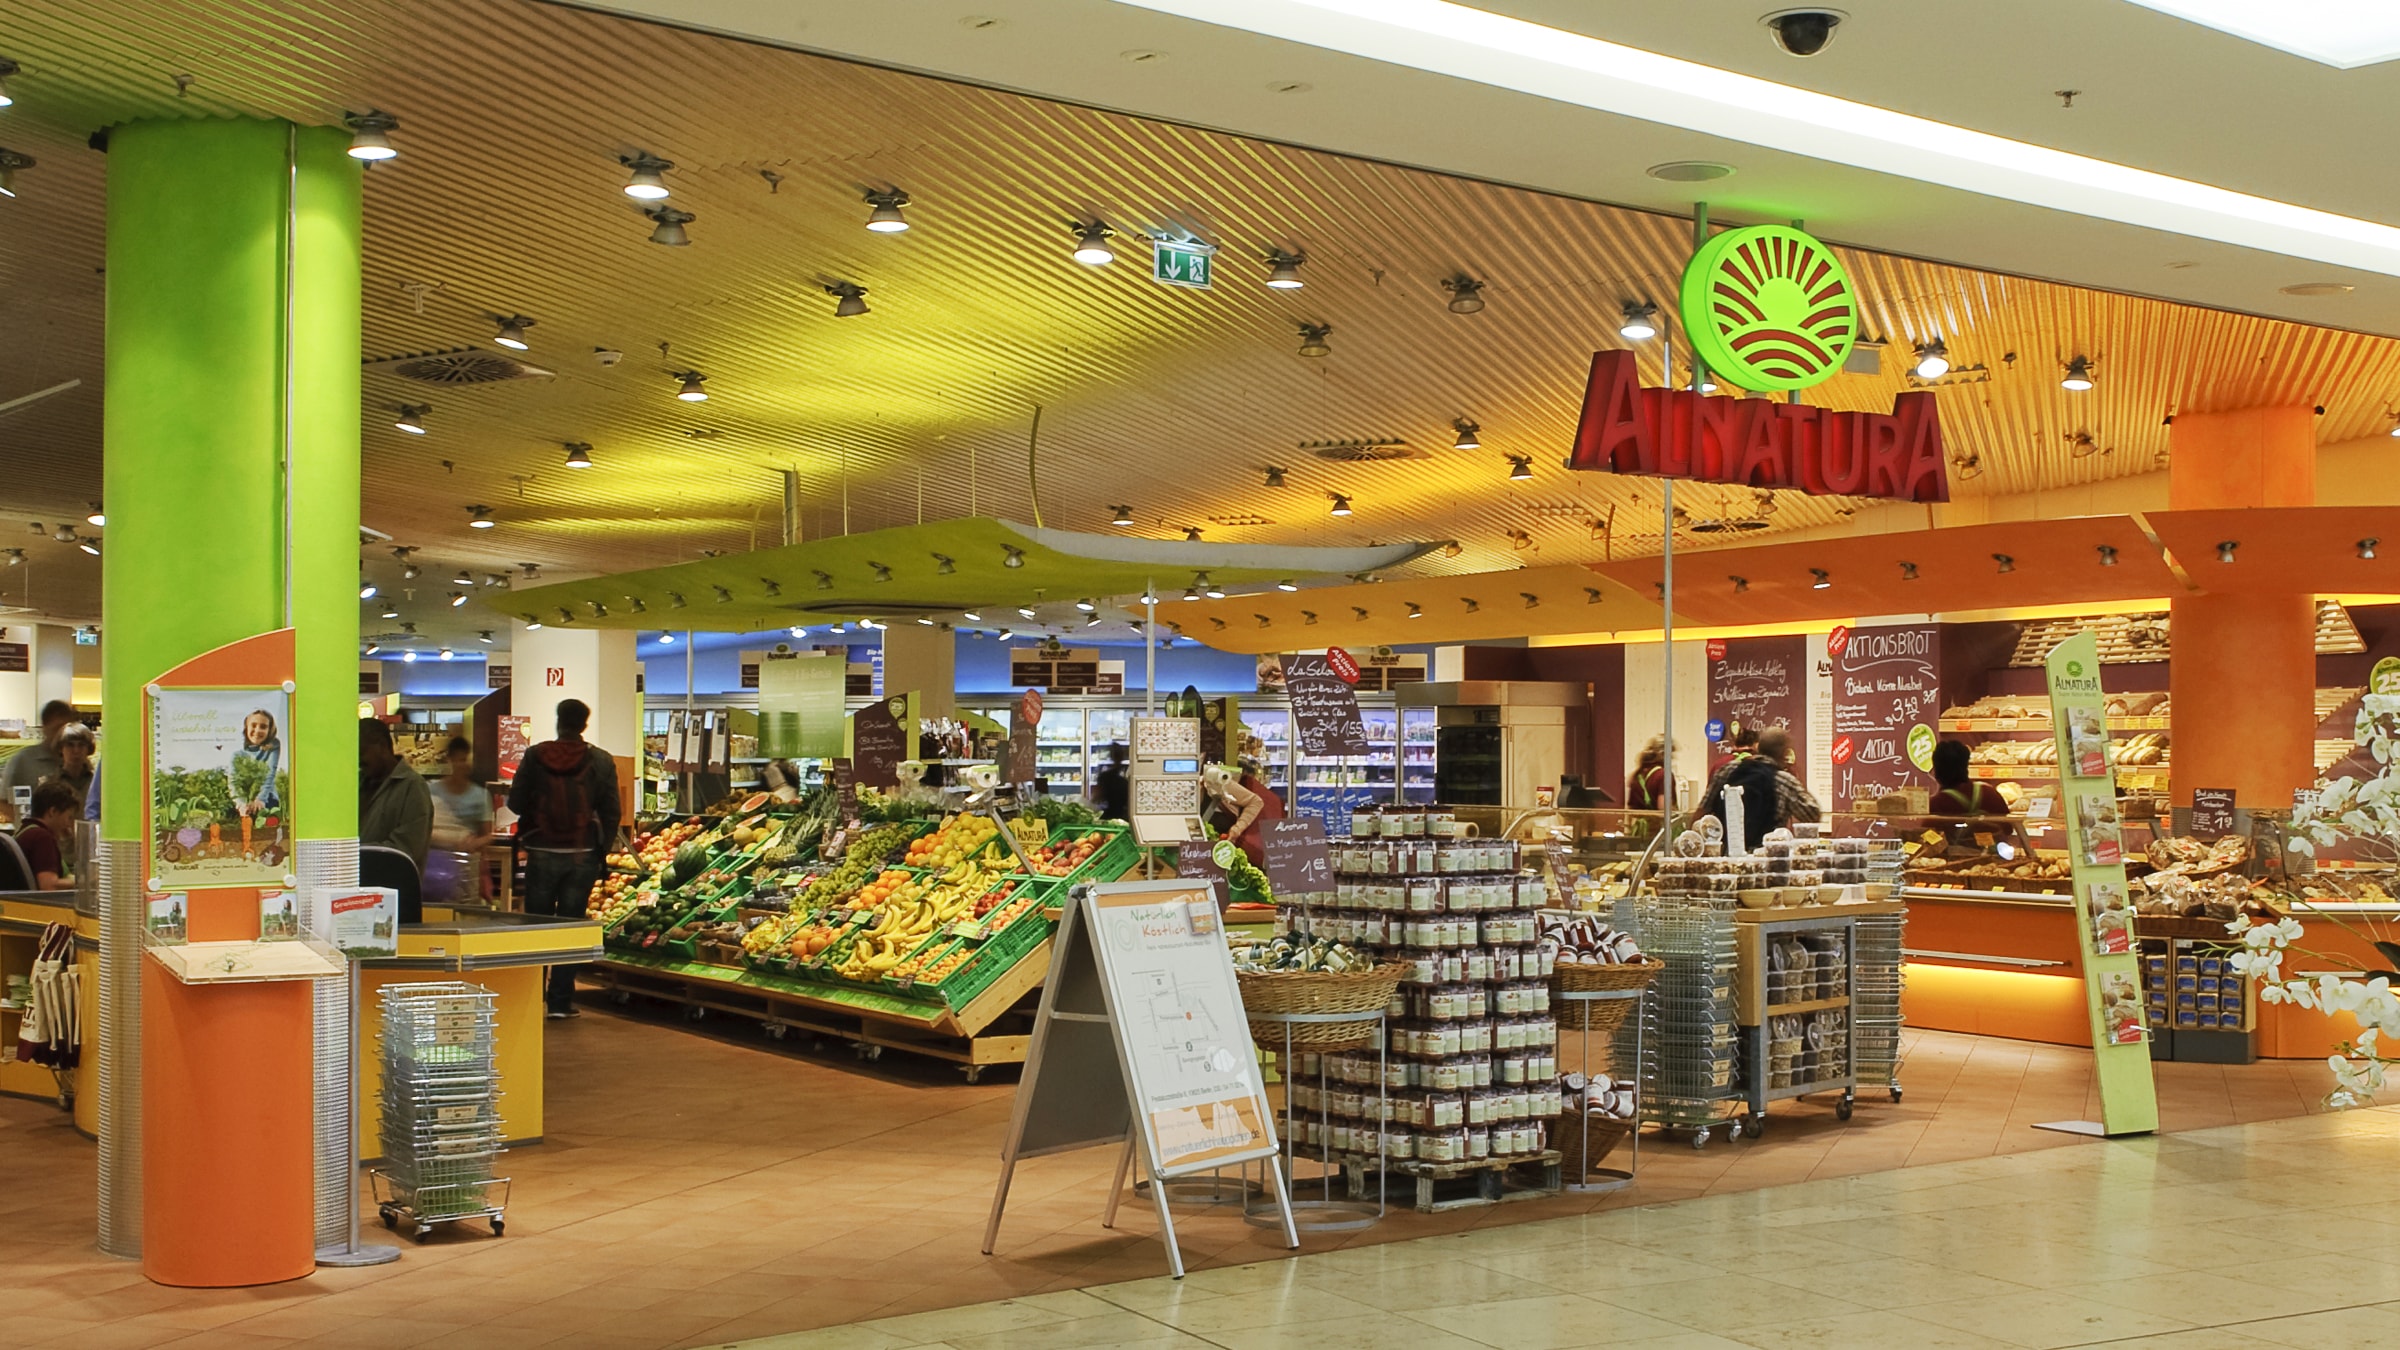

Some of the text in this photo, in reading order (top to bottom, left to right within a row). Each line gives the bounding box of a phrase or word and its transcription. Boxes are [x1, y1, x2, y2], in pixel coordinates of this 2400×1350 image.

[1569, 349, 1950, 503] ALNATURA
[1844, 630, 1937, 659] AKTIONSBROT
[1331, 658, 1349, 677] Preis
[1332, 649, 1358, 677] Aktions
[2056, 675, 2098, 691] ALNATURA
[2376, 672, 2400, 694] 25
[1862, 739, 1896, 759] AKTION
[1911, 734, 1932, 758] 25
[1017, 827, 1047, 841] ALNATURA
